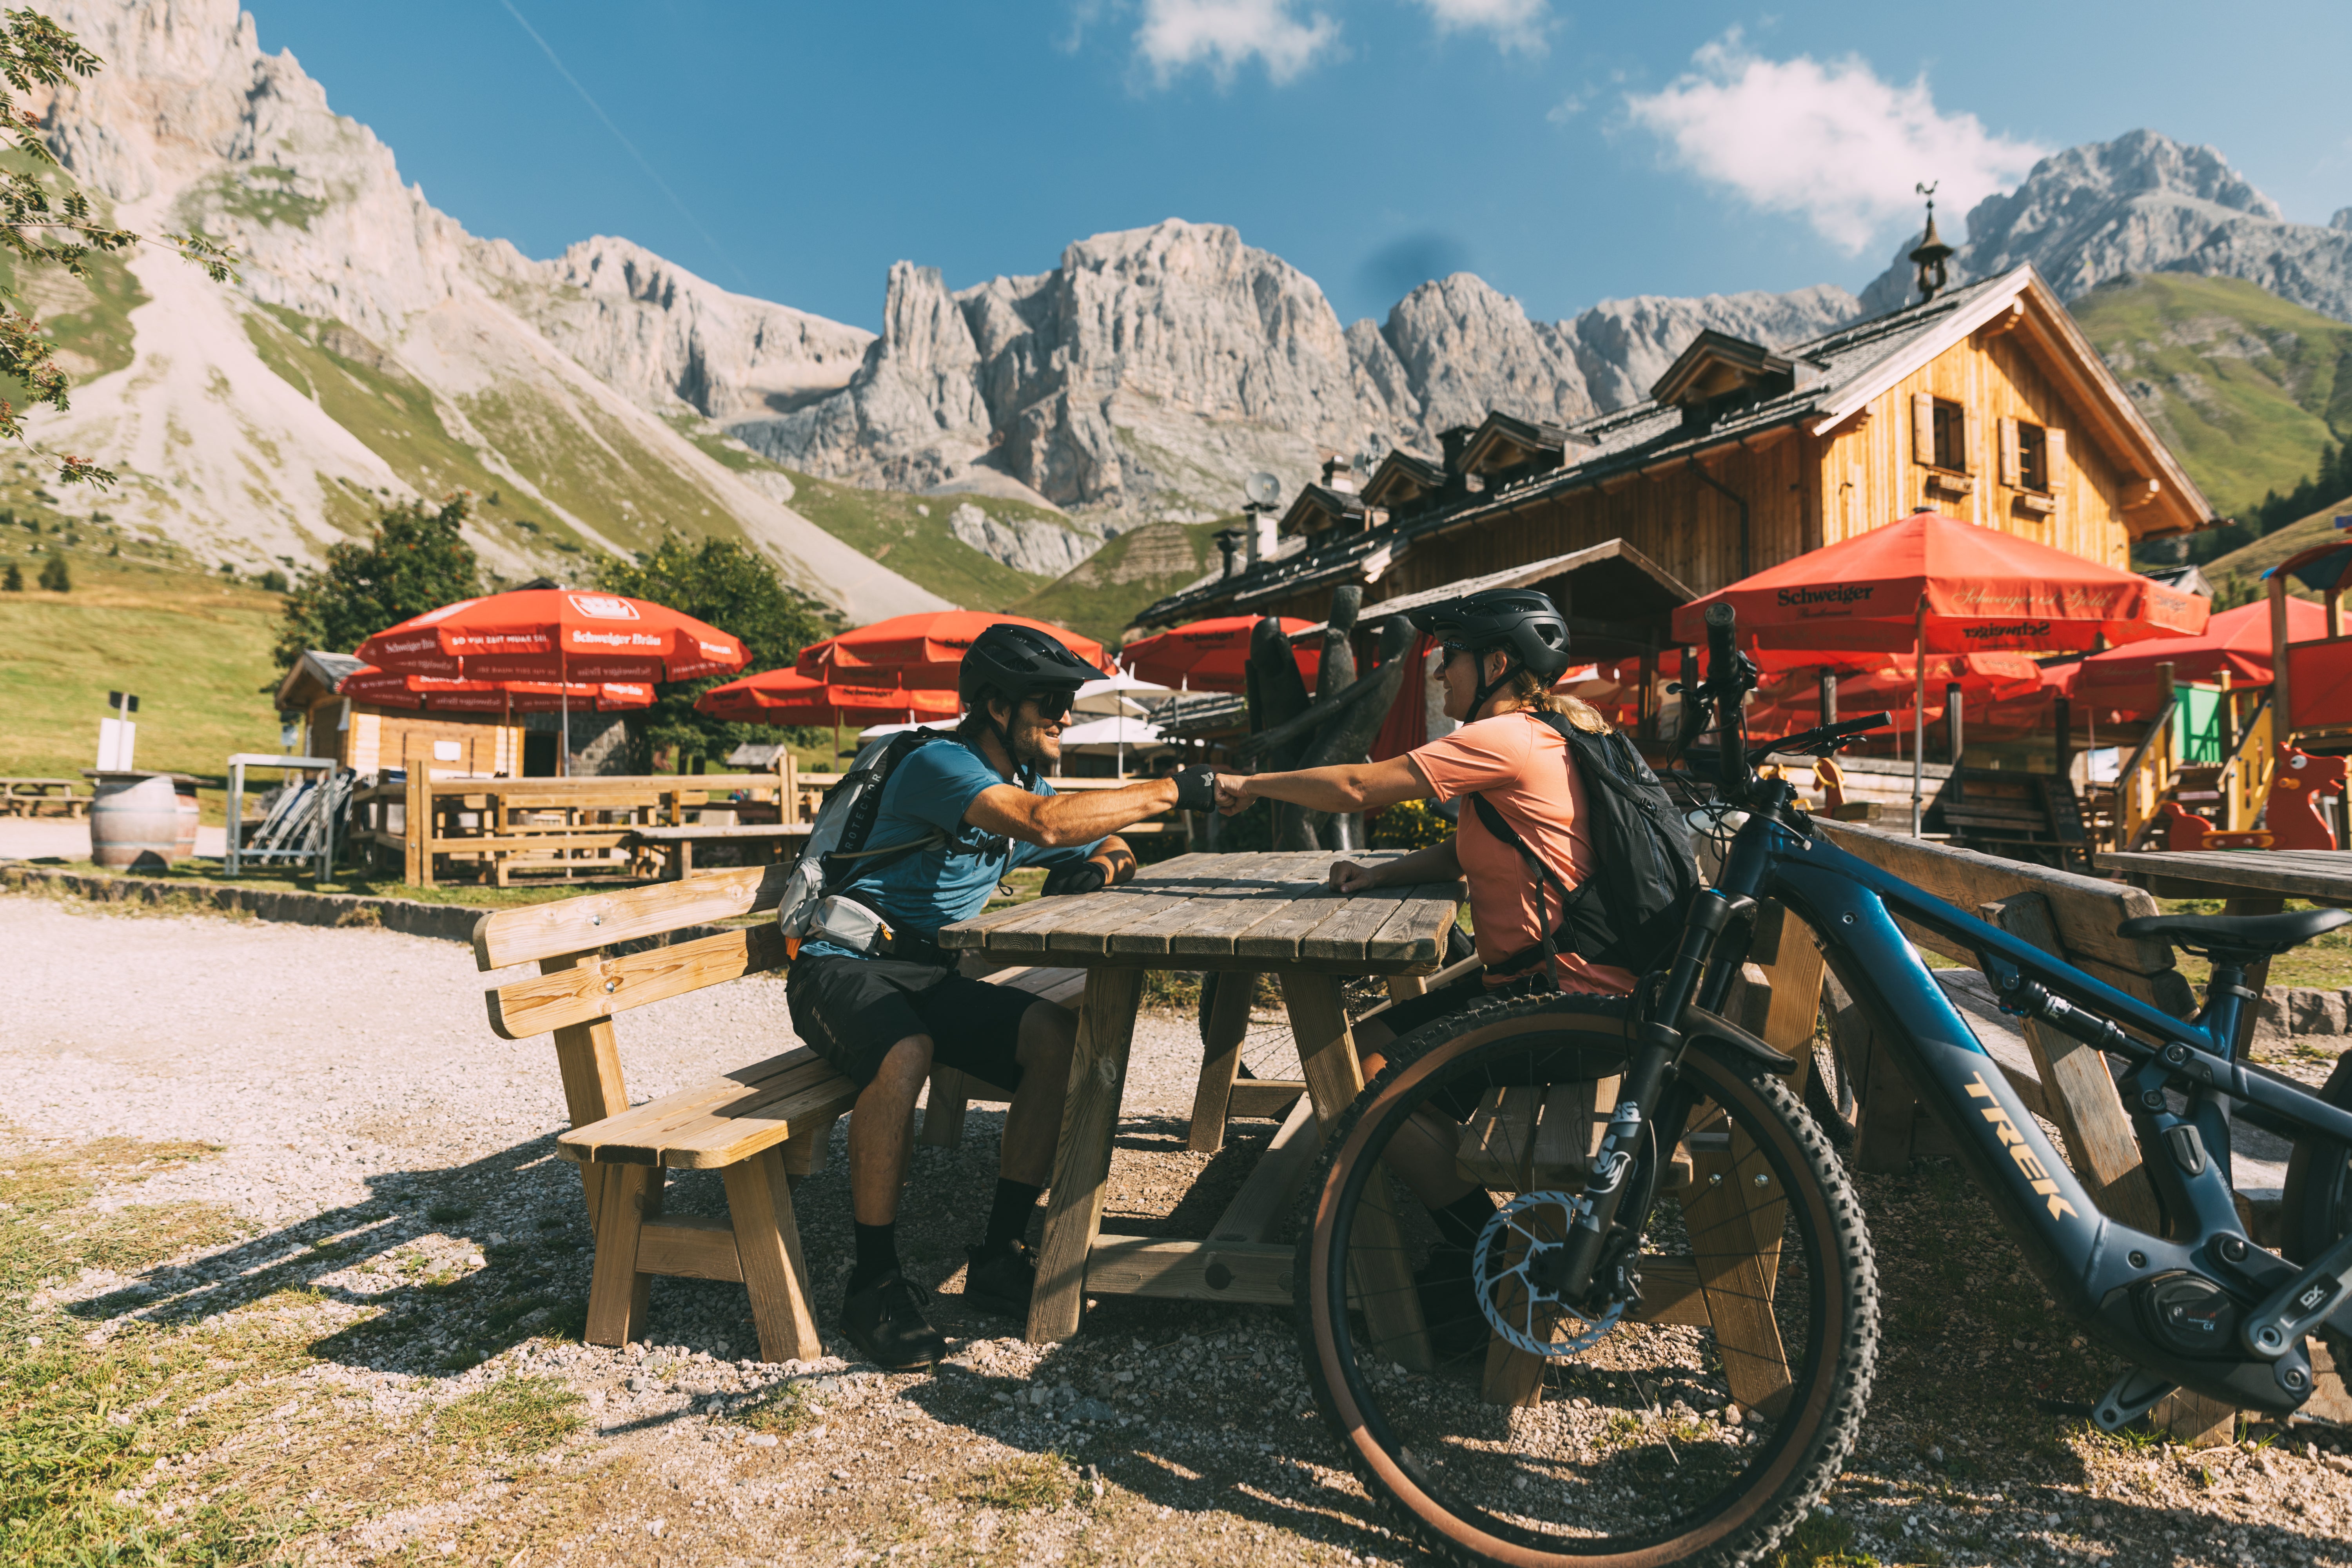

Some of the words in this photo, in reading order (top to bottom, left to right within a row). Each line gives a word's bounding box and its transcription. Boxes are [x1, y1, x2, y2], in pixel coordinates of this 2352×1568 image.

[1777, 585, 1874, 607] Schweiger
[573, 630, 631, 646] Schweiger
[632, 633, 661, 646] Bräu
[842, 773, 881, 860] ROTECTOR
[812, 1006, 845, 1052] ENDU
[1964, 1071, 2078, 1221] TREK
[2299, 1284, 2324, 1307] GX
